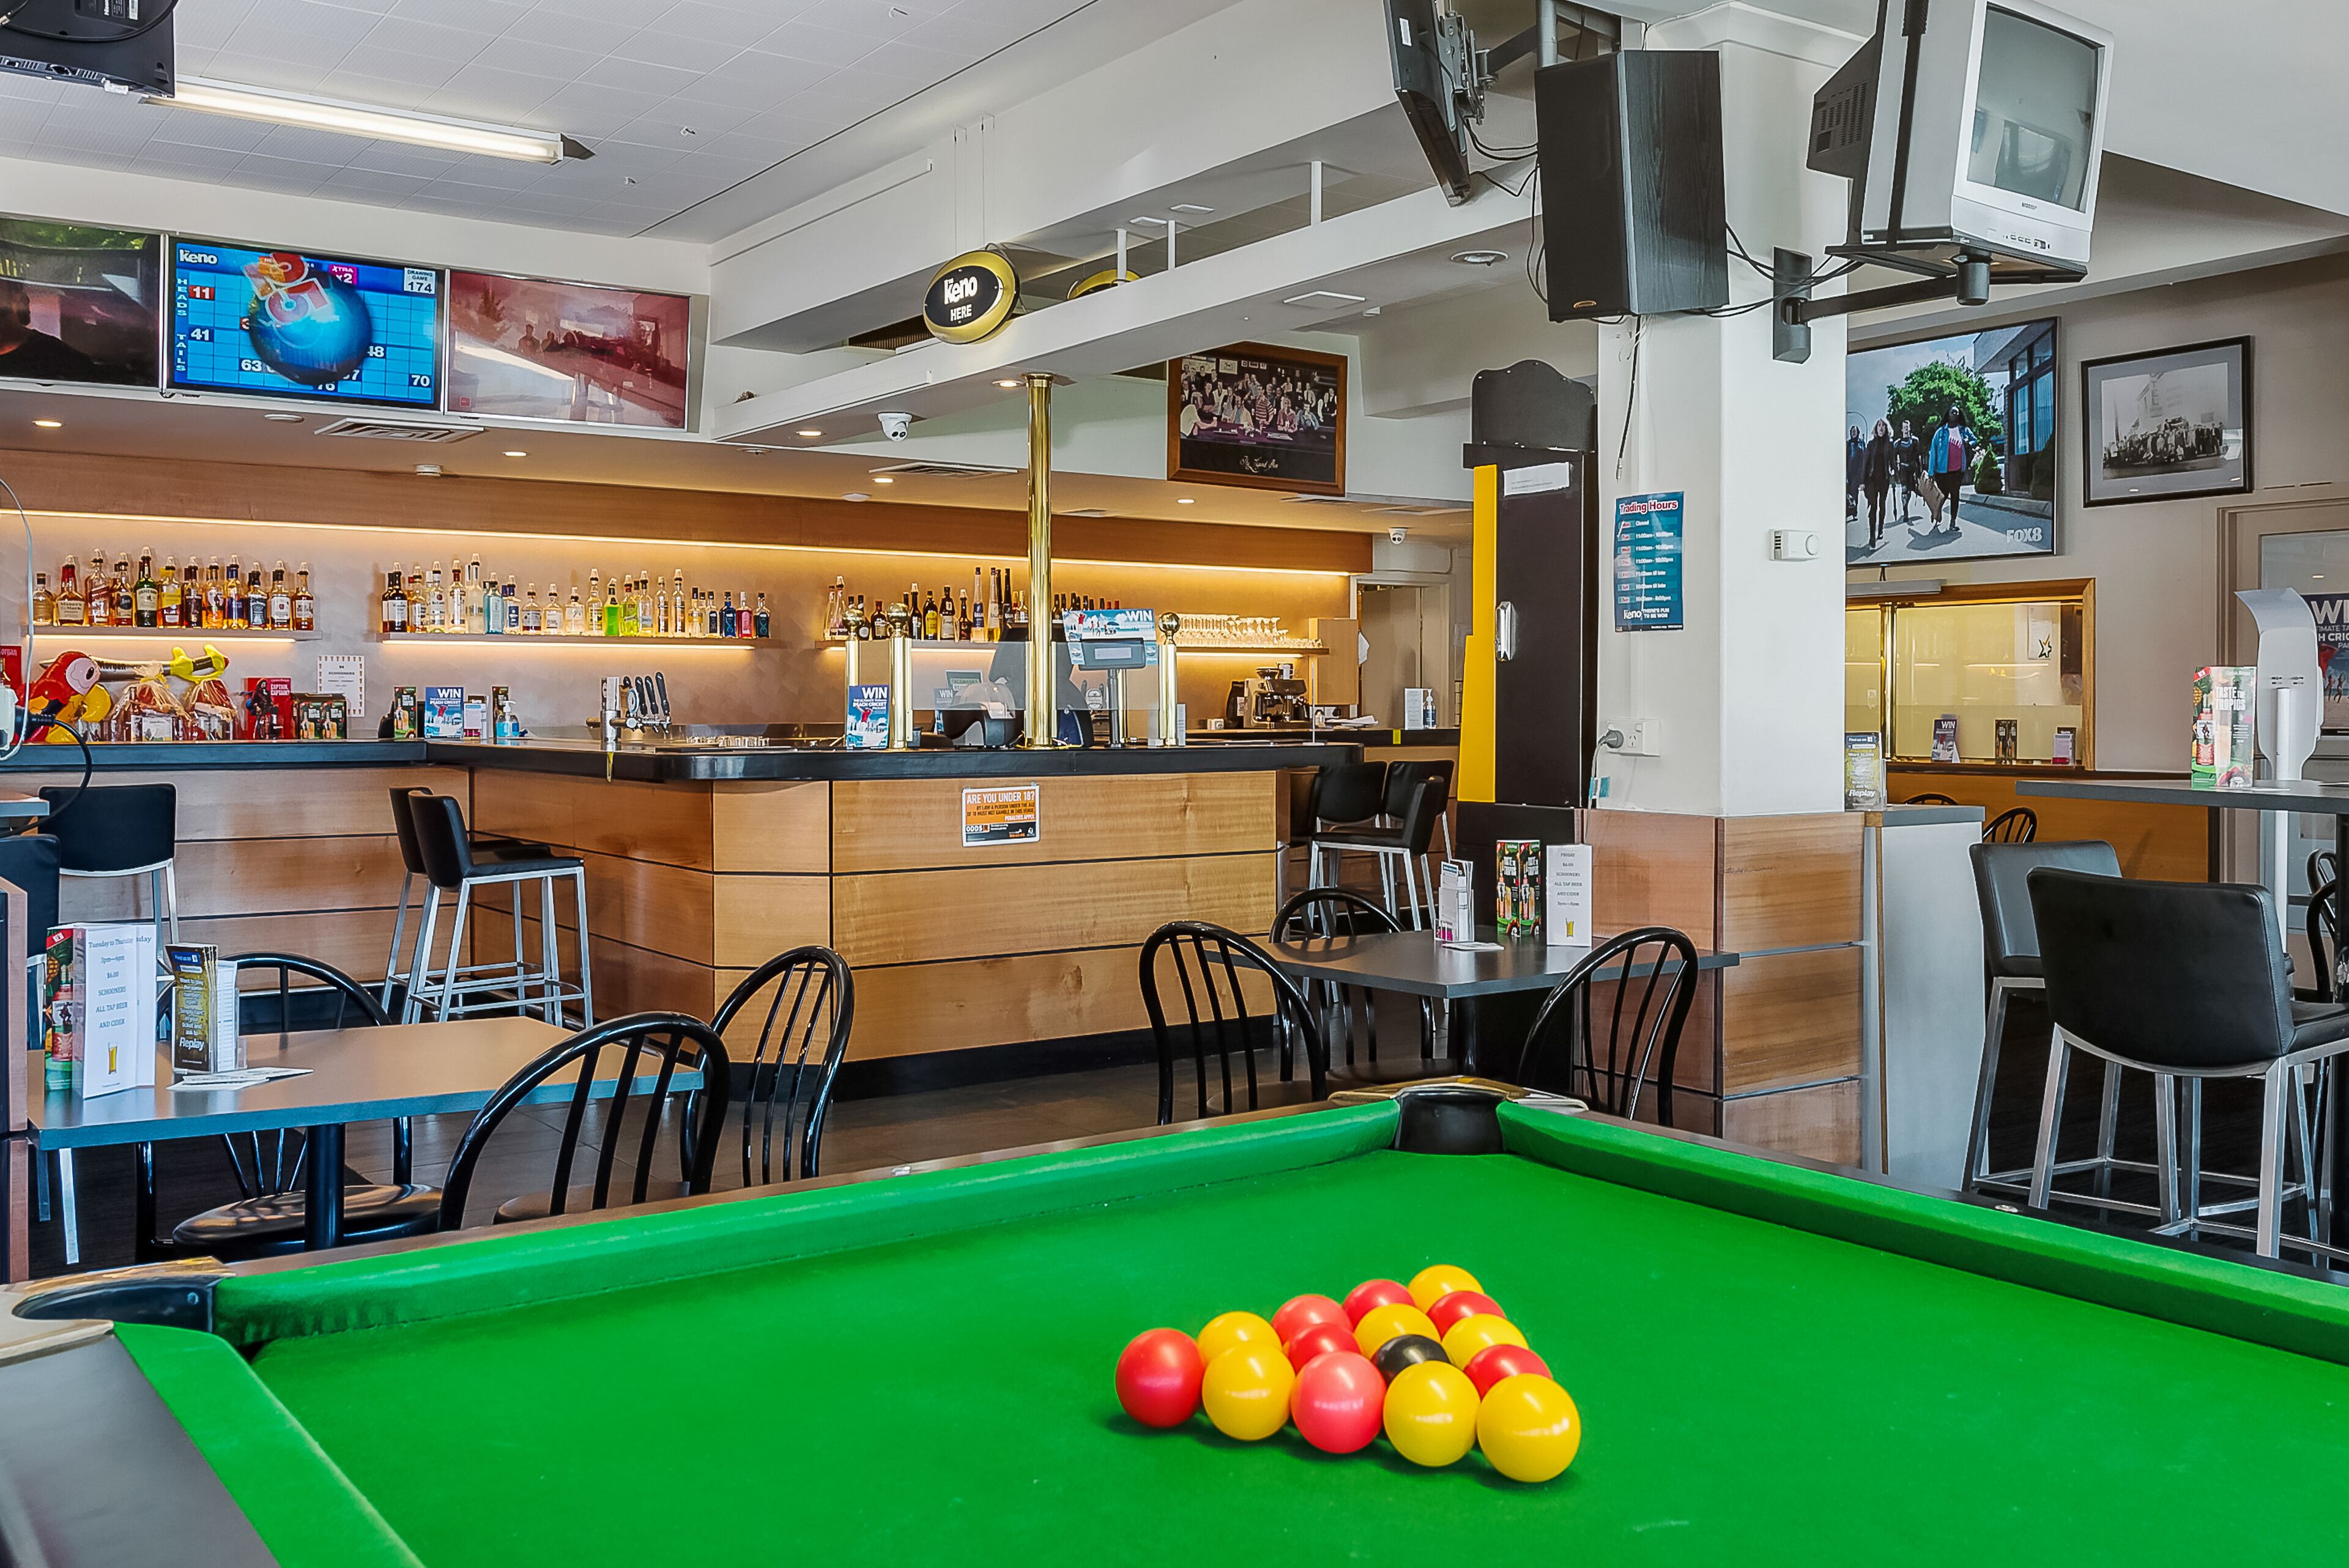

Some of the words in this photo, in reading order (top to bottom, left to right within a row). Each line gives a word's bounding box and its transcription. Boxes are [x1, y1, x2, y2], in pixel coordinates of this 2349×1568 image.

[193, 286, 210, 299] 11
[407, 281, 432, 293] 174
[177, 278, 187, 316] HEADS
[950, 304, 972, 321] HERE
[191, 329, 209, 341] 41
[176, 333, 187, 371] TAILS
[241, 359, 262, 372] 63
[411, 374, 430, 387] 70
[1620, 502, 1647, 515] Trading
[1649, 500, 1678, 511] Hours
[2006, 527, 2043, 543] FOX8
[1126, 610, 1152, 622] WIN
[437, 689, 461, 698] WIN
[862, 687, 887, 699] WIN
[940, 689, 953, 698] WIN
[2215, 686, 2237, 699] TASTE
[2215, 698, 2246, 711] TROPICS
[1941, 721, 1956, 729] WIN
[967, 793, 981, 804] ARE
[982, 793, 996, 803] YOU
[998, 792, 1021, 802] UNDER
[1023, 791, 1034, 801] 18?
[1849, 789, 1876, 798] Replay
[98, 986, 127, 997] SCHOONERS
[179, 1036, 204, 1051] Replay
